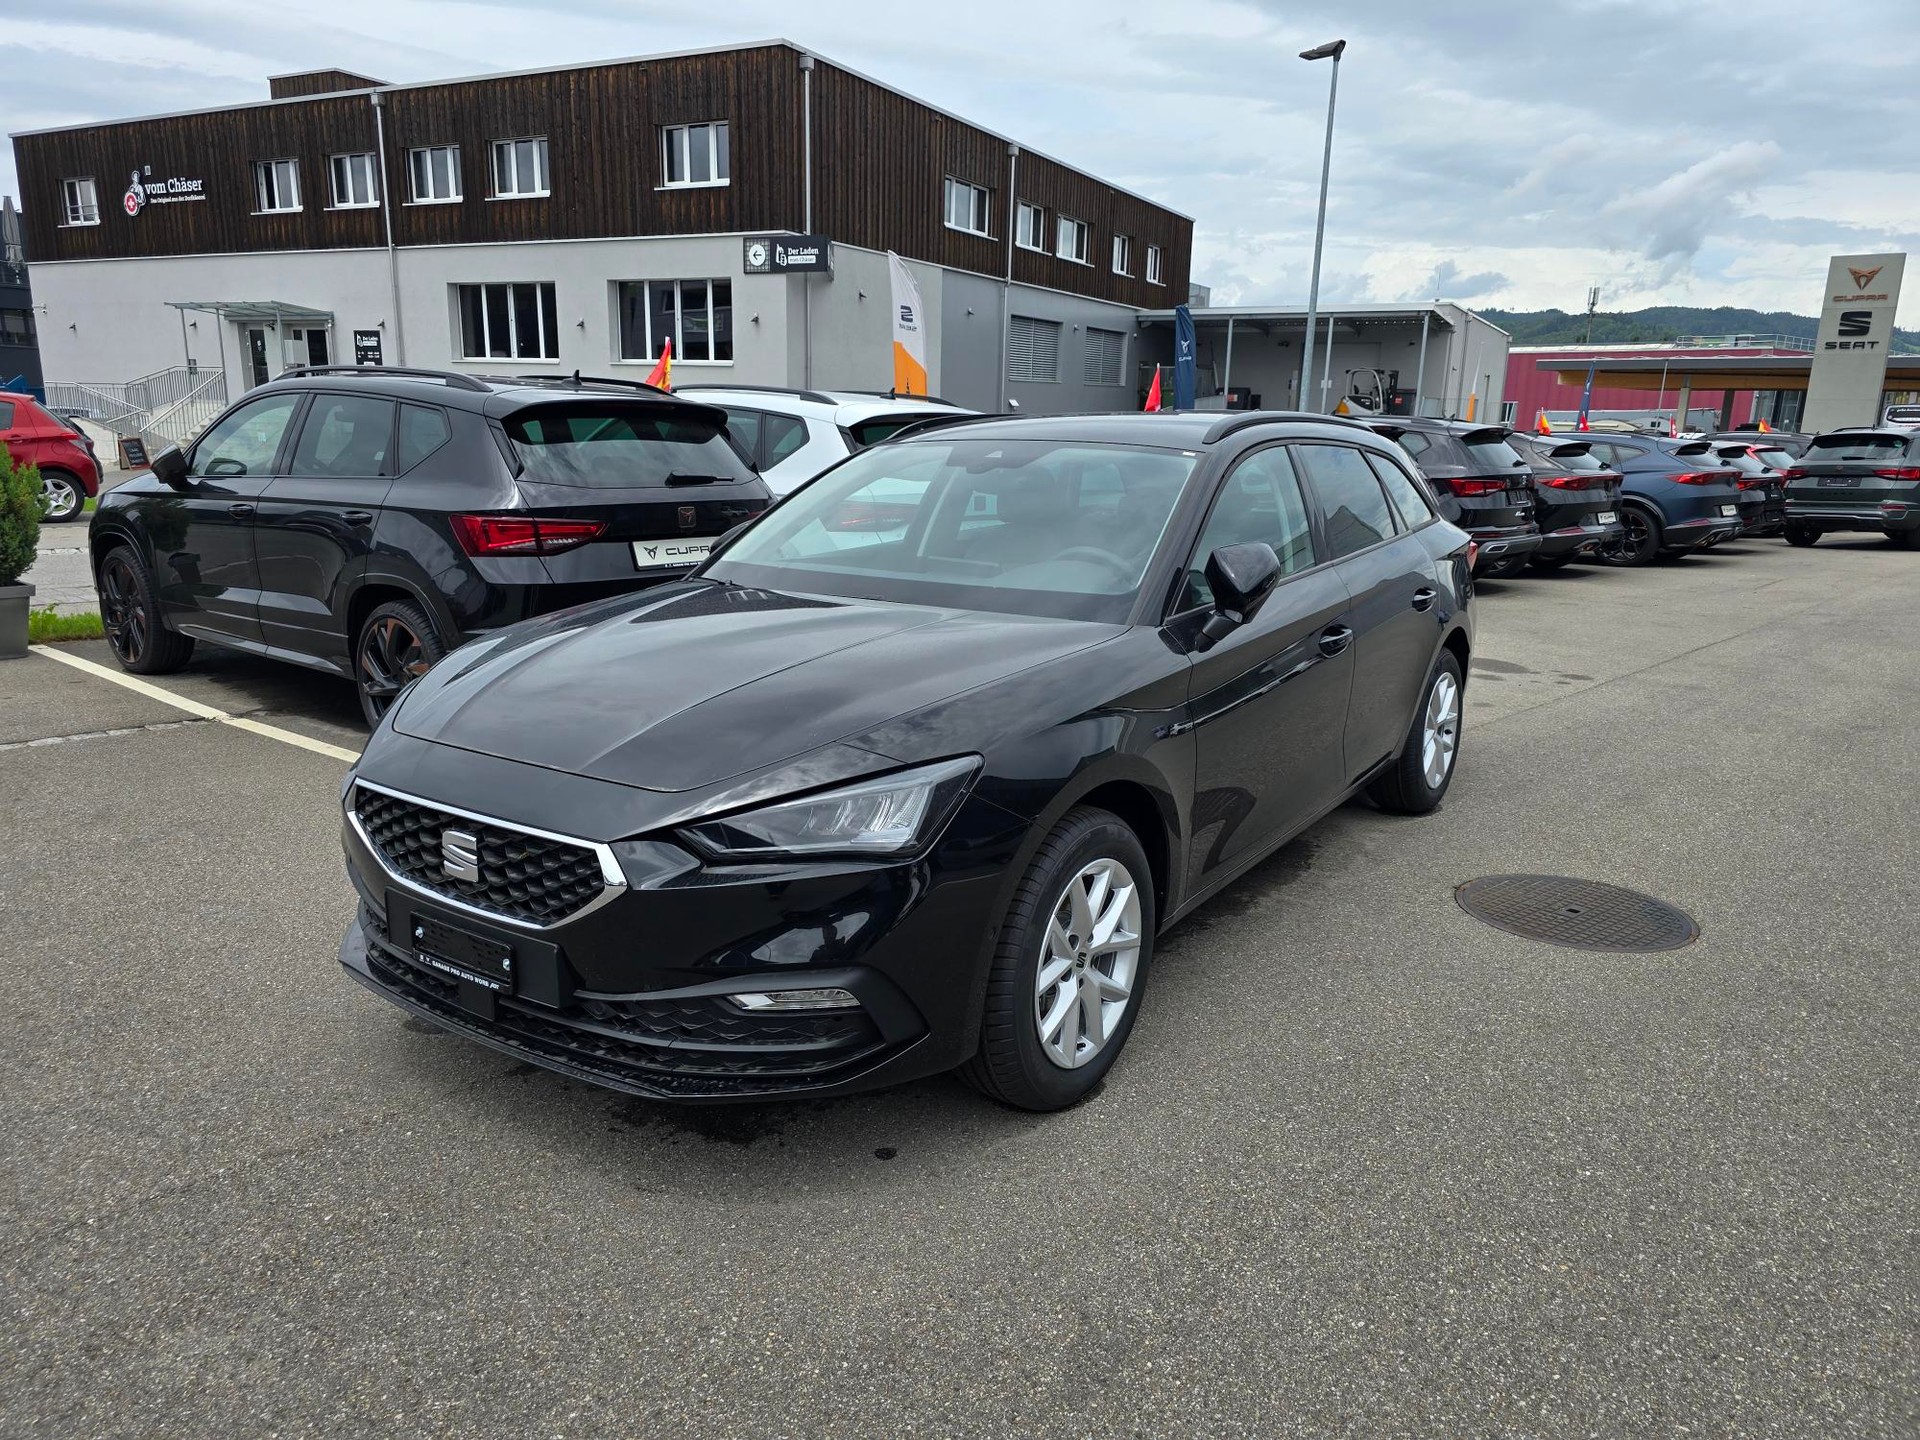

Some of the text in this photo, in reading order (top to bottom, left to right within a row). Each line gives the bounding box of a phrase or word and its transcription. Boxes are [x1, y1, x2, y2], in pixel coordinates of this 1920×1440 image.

[145, 177, 202, 194] vom Chäser
[787, 246, 819, 255] Der Laden
[1833, 294, 1889, 302] CUPRA
[1824, 341, 1879, 350] SEAT
[665, 545, 709, 555] CUPR
[450, 967, 460, 976] PRO
[460, 972, 474, 982] AUTO
